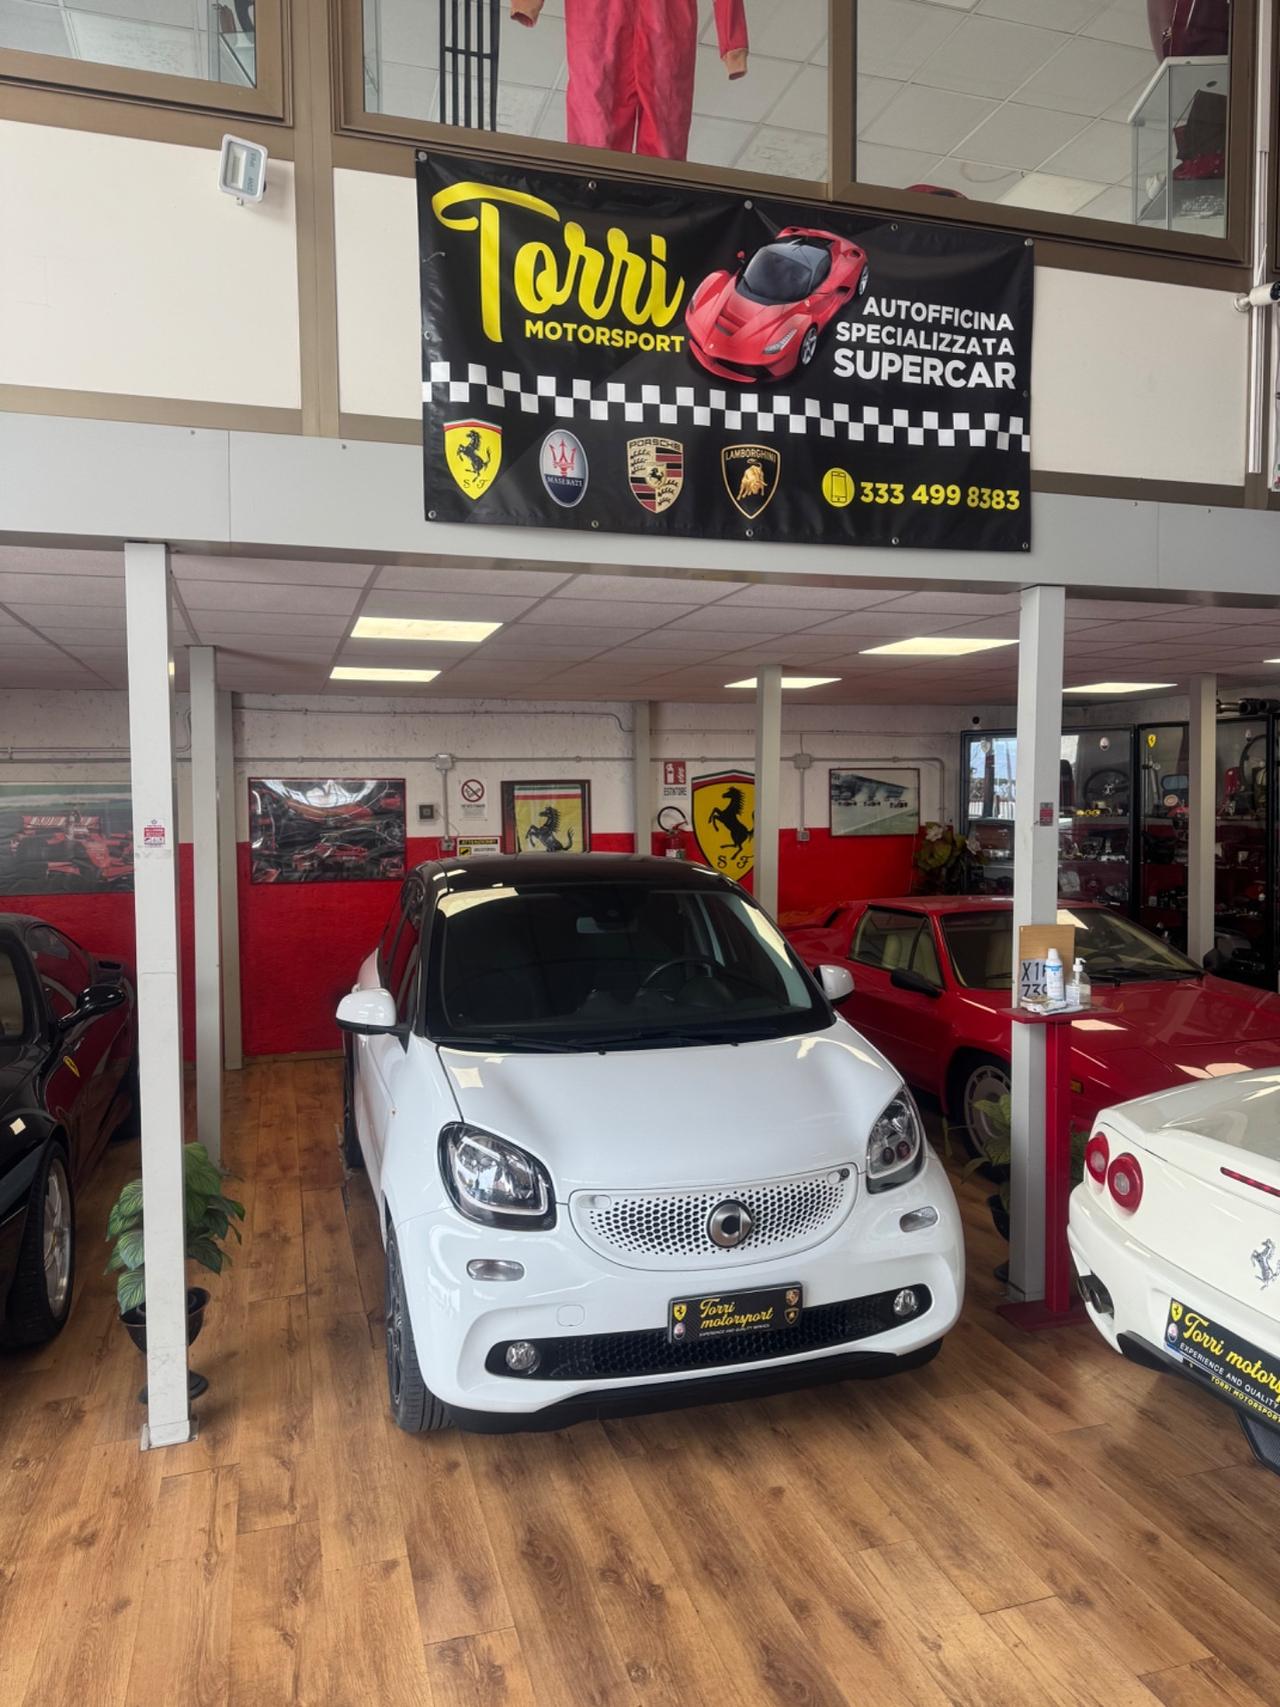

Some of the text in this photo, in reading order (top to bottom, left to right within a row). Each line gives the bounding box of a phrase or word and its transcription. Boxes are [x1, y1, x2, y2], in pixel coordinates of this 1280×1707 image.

[432, 182, 686, 343] Torri
[863, 296, 1015, 332] AUTOFFICINA
[525, 319, 686, 354] MOTORSPORT
[835, 320, 1015, 357] SPECIALIZZATA
[833, 347, 1017, 391] SUPERCAR
[629, 437, 682, 451] PORSCHE
[725, 447, 777, 463] LAMBORGHINI
[546, 476, 583, 488] MASERATI
[860, 481, 1020, 511] 333 499 8383
[700, 1298, 735, 1318] Torri
[700, 1307, 774, 1329] motorsport
[1183, 1312, 1225, 1357] Torri
[1179, 1342, 1280, 1410] EXPERIENCE AND QUALITY
[1211, 1376, 1232, 1392] TORRI
